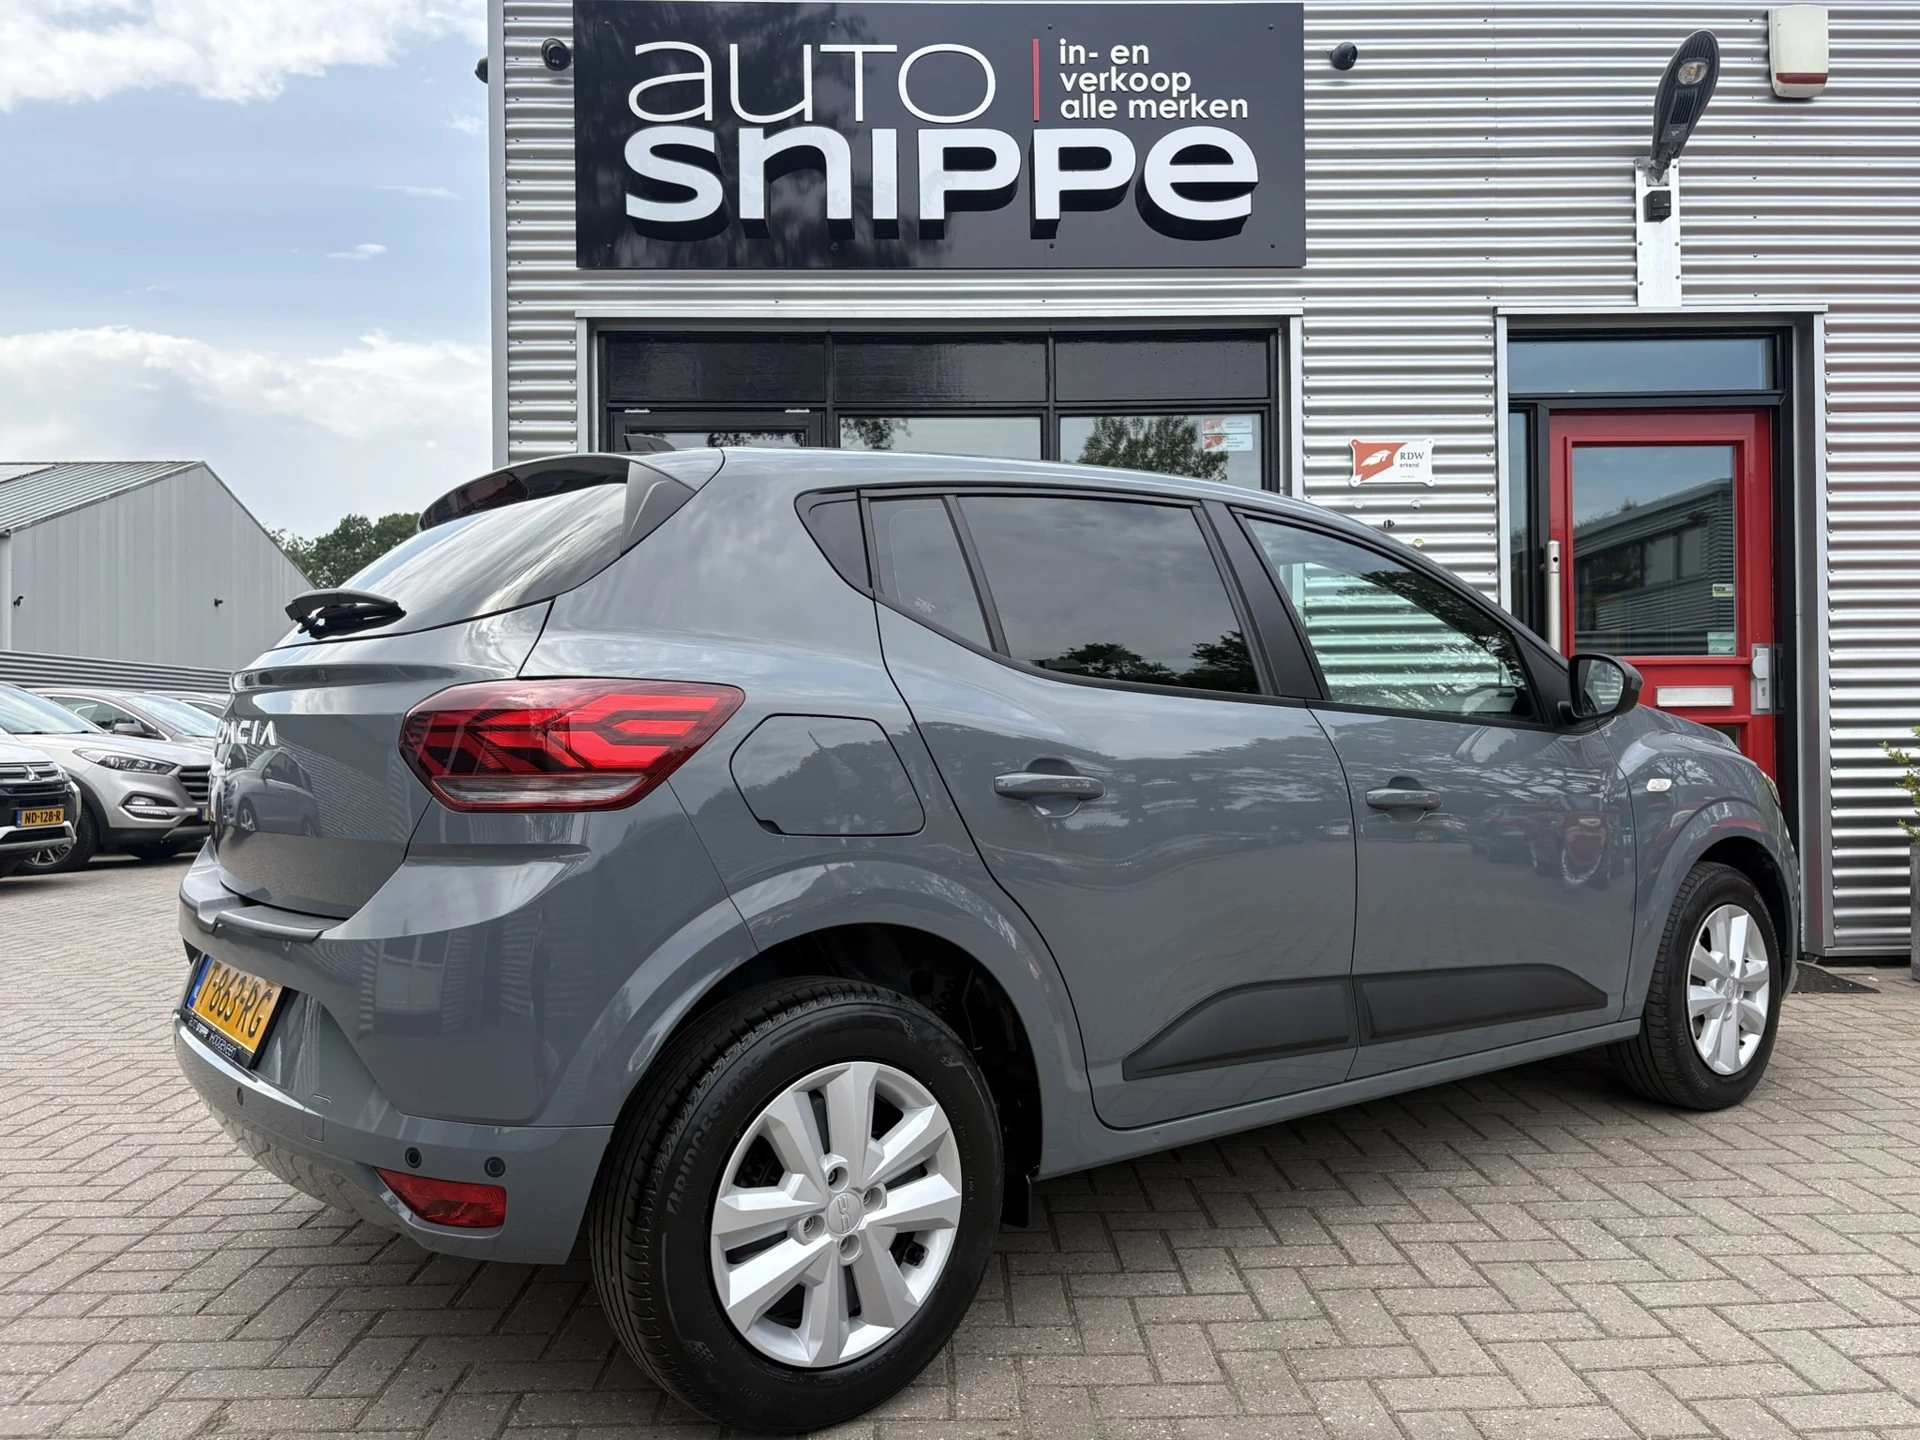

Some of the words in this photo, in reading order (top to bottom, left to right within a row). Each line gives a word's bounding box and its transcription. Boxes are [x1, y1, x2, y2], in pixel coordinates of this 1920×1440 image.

[1059, 38, 1099, 64] in-
[1110, 44, 1150, 64] en
[1059, 66, 1192, 98] verkoop
[1060, 93, 1118, 119] alle
[1128, 93, 1249, 119] merken
[1400, 452, 1425, 460] RDW
[25, 811, 61, 824] ND-128-R
